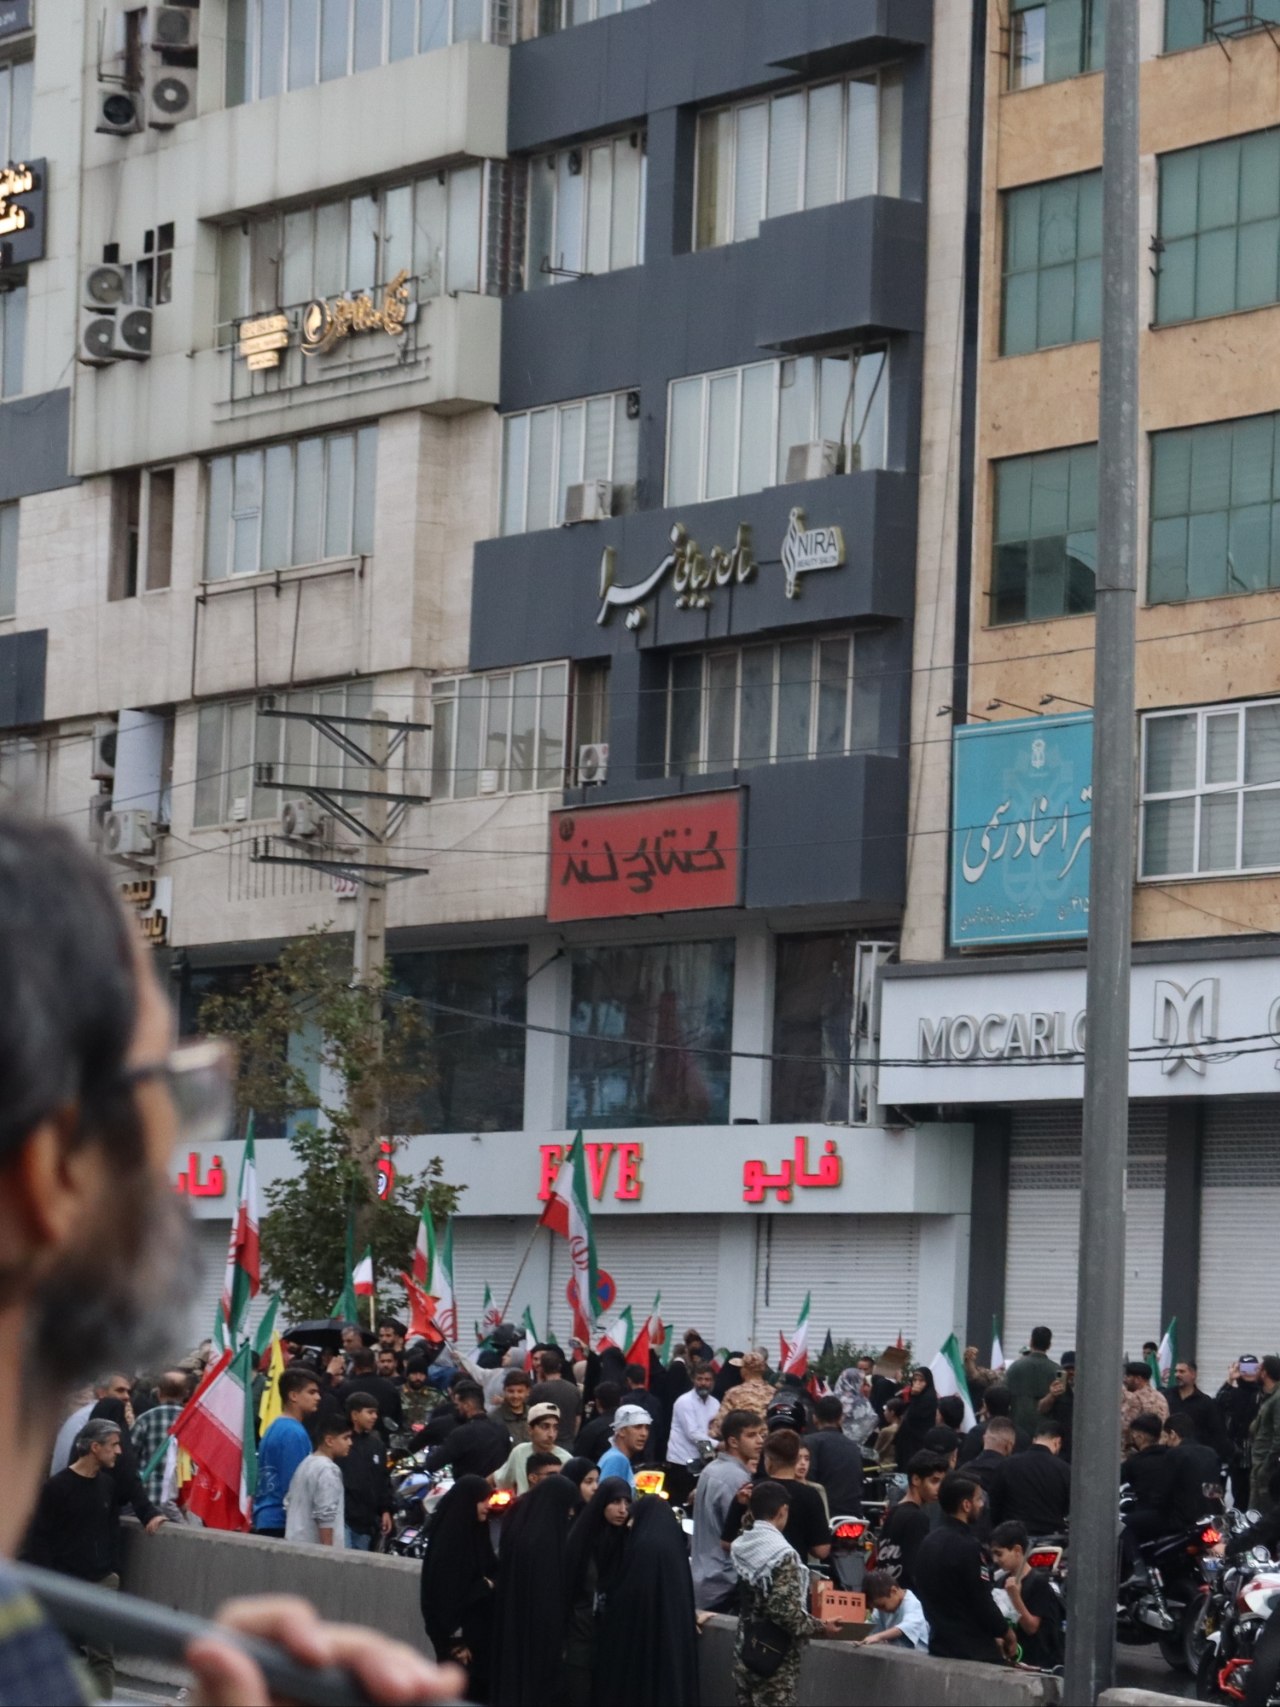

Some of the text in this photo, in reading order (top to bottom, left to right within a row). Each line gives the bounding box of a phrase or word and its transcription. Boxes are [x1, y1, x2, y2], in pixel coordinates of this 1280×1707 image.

[798, 529, 837, 557] NIRA
[962, 799, 1010, 883] رسمی
[537, 1142, 643, 1201] FVE
[743, 1136, 841, 1203] فایو
